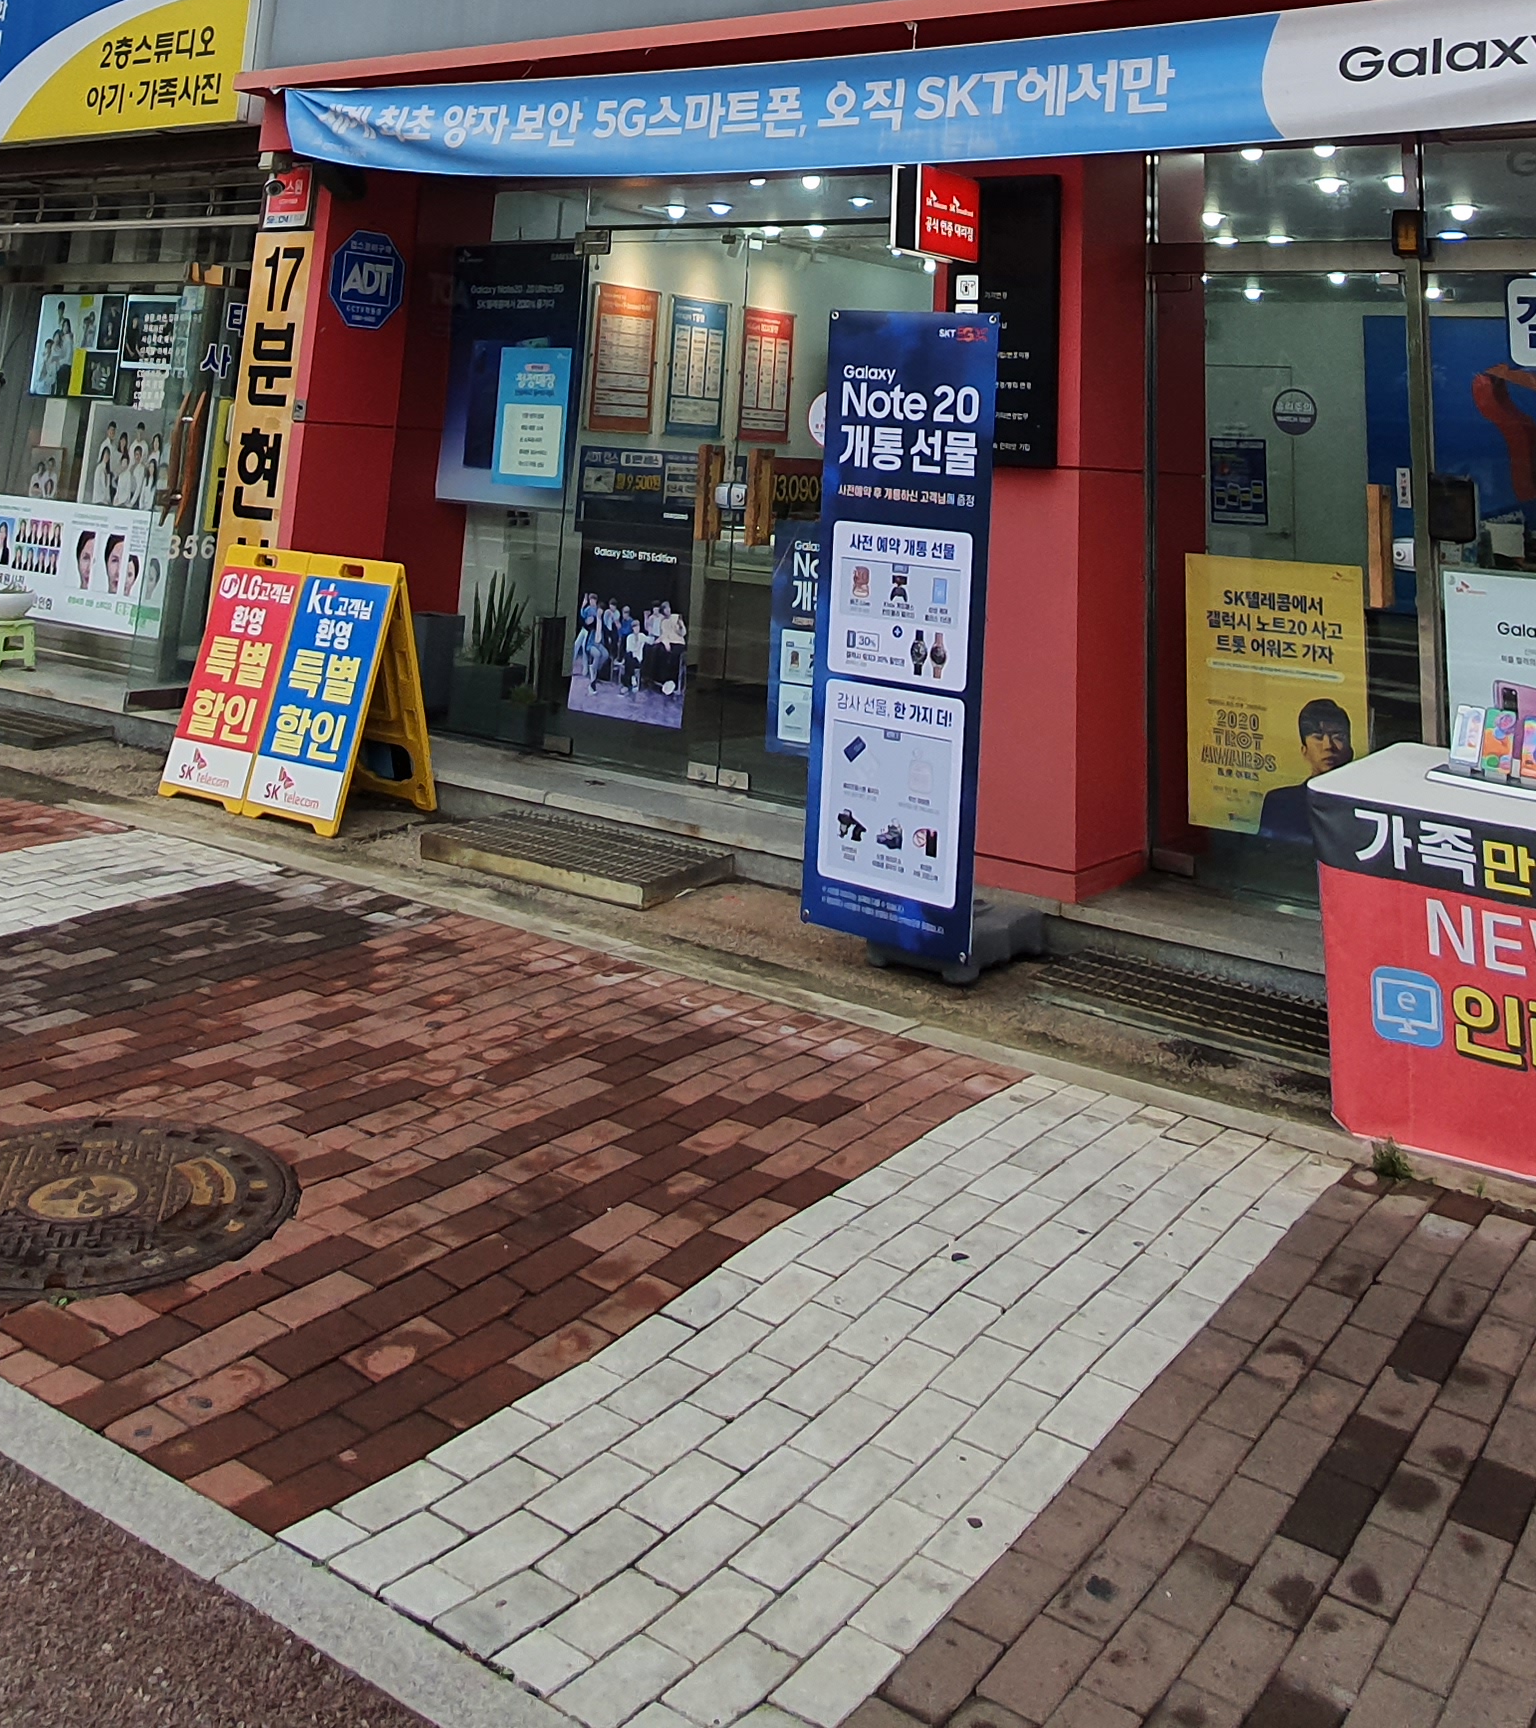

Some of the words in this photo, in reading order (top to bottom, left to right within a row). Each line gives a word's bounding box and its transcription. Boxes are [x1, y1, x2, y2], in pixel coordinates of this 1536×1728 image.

[100, 24, 216, 70] 2층스튜디오
[378, 101, 432, 143] 최초
[823, 81, 906, 135] 오직
[916, 54, 1174, 122] SKT에서만
[342, 260, 393, 298] ADT
[844, 365, 896, 384] Galaxy
[841, 382, 927, 422] Note
[933, 385, 980, 424] 20
[839, 425, 904, 471] 개통
[910, 429, 978, 477] 선물
[850, 534, 874, 551] 사전
[877, 536, 901, 553] 예약
[904, 539, 927, 557] 개통
[931, 542, 955, 560] 선물
[230, 604, 267, 636] 환영
[1223, 590, 1323, 616] SK텔레콤에서
[314, 617, 353, 651] 환영
[1206, 610, 1251, 631] 갤럭시
[1257, 616, 1307, 637] 노트20
[1311, 621, 1343, 641] 사고
[205, 635, 273, 689] 특별
[1216, 635, 1246, 654] 트롯
[1251, 638, 1298, 660] 어워즈
[1302, 643, 1334, 664] 가자
[288, 648, 361, 705] 특별
[186, 688, 258, 745] 할인
[837, 693, 861, 712] 감사
[893, 701, 907, 720] 한
[910, 705, 933, 724] 가지
[936, 710, 952, 728] 더!
[1216, 710, 1260, 730] 2020
[270, 702, 347, 763] 할인
[1212, 727, 1264, 751] TROT
[1201, 744, 1278, 772] AWARDS
[178, 763, 194, 781] SK
[196, 772, 230, 789] telecom
[264, 781, 280, 801] SK
[283, 791, 320, 810] telecom
[1353, 808, 1536, 898] 가족만
